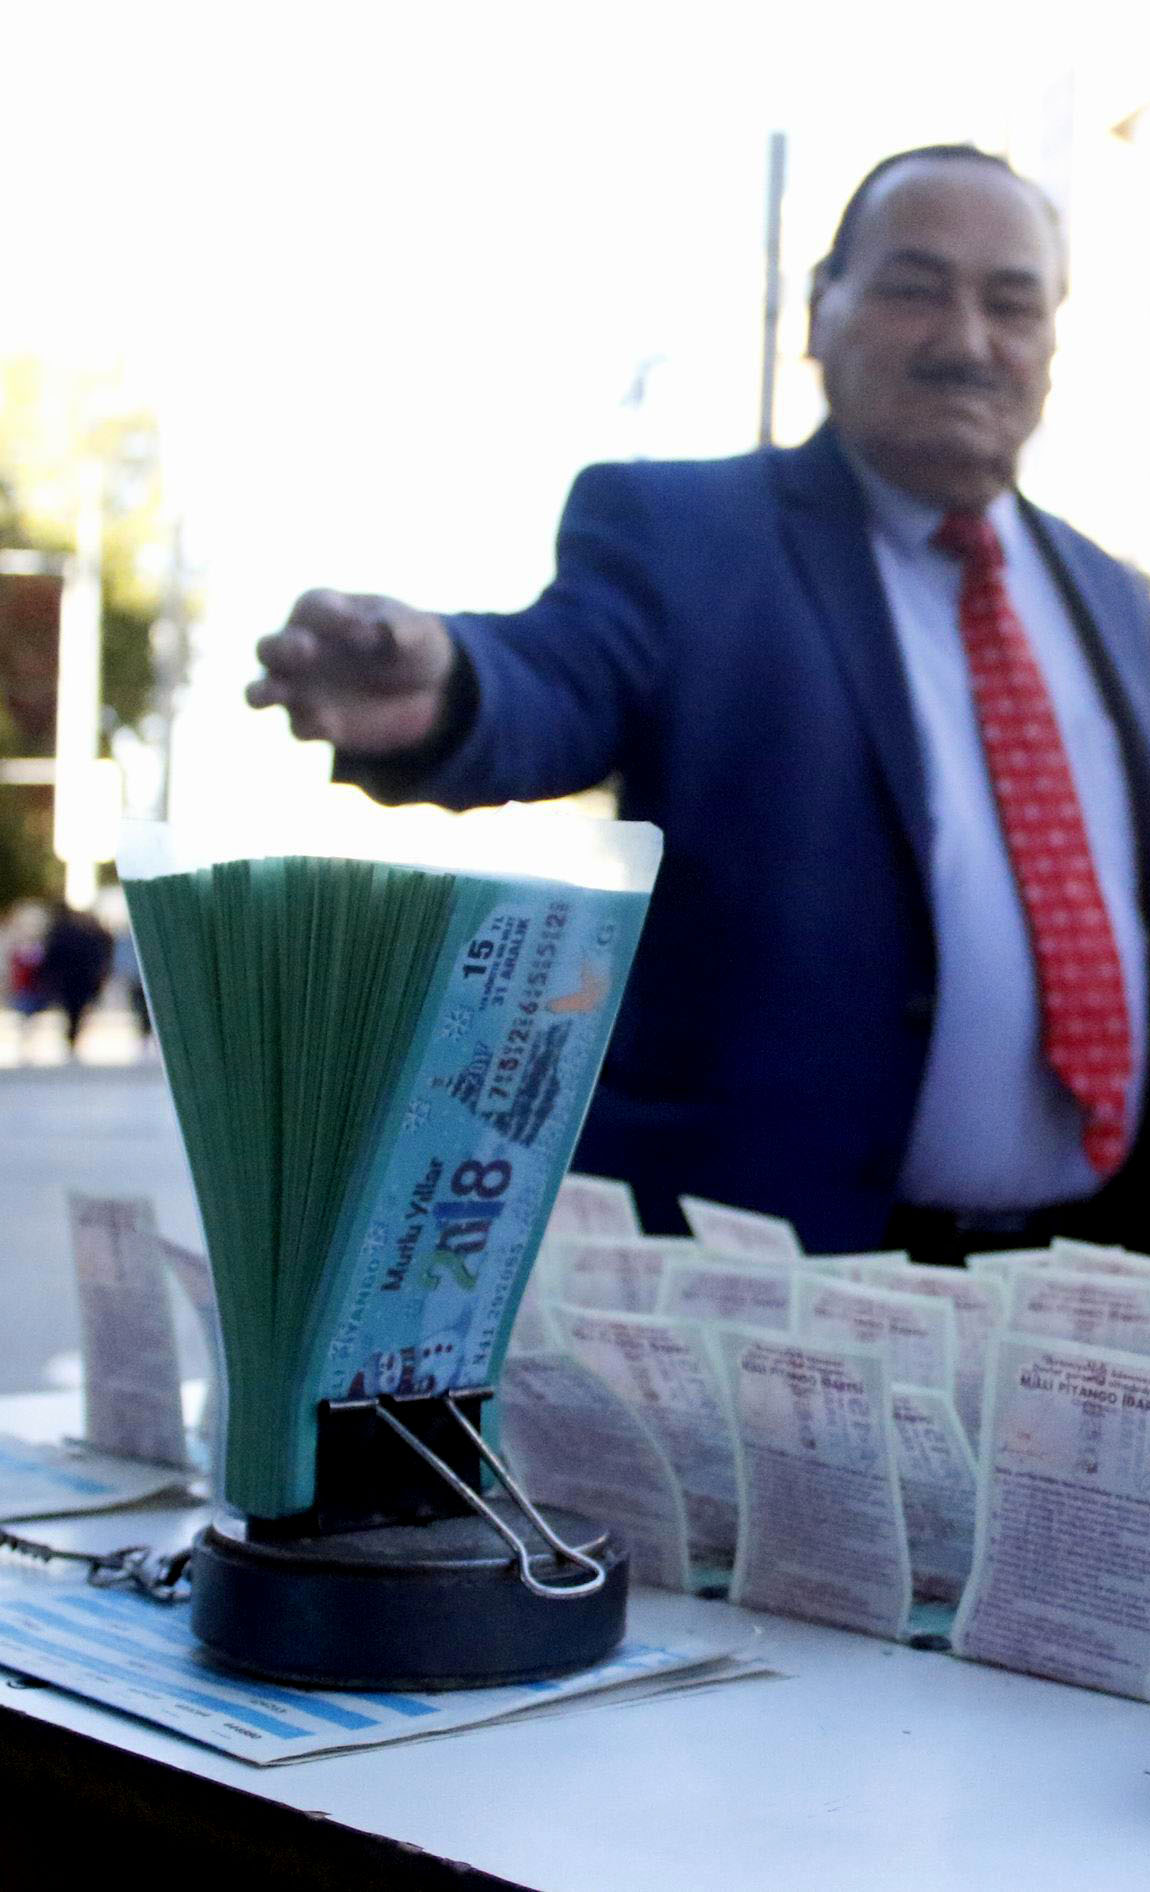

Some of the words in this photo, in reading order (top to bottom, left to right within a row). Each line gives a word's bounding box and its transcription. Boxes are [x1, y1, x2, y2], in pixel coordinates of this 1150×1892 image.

[462, 938, 494, 980] 15
[381, 1215, 423, 1293] Mutlu
[418, 1158, 512, 1293] 2018
[1058, 1378, 1117, 1404] PİYANGO
